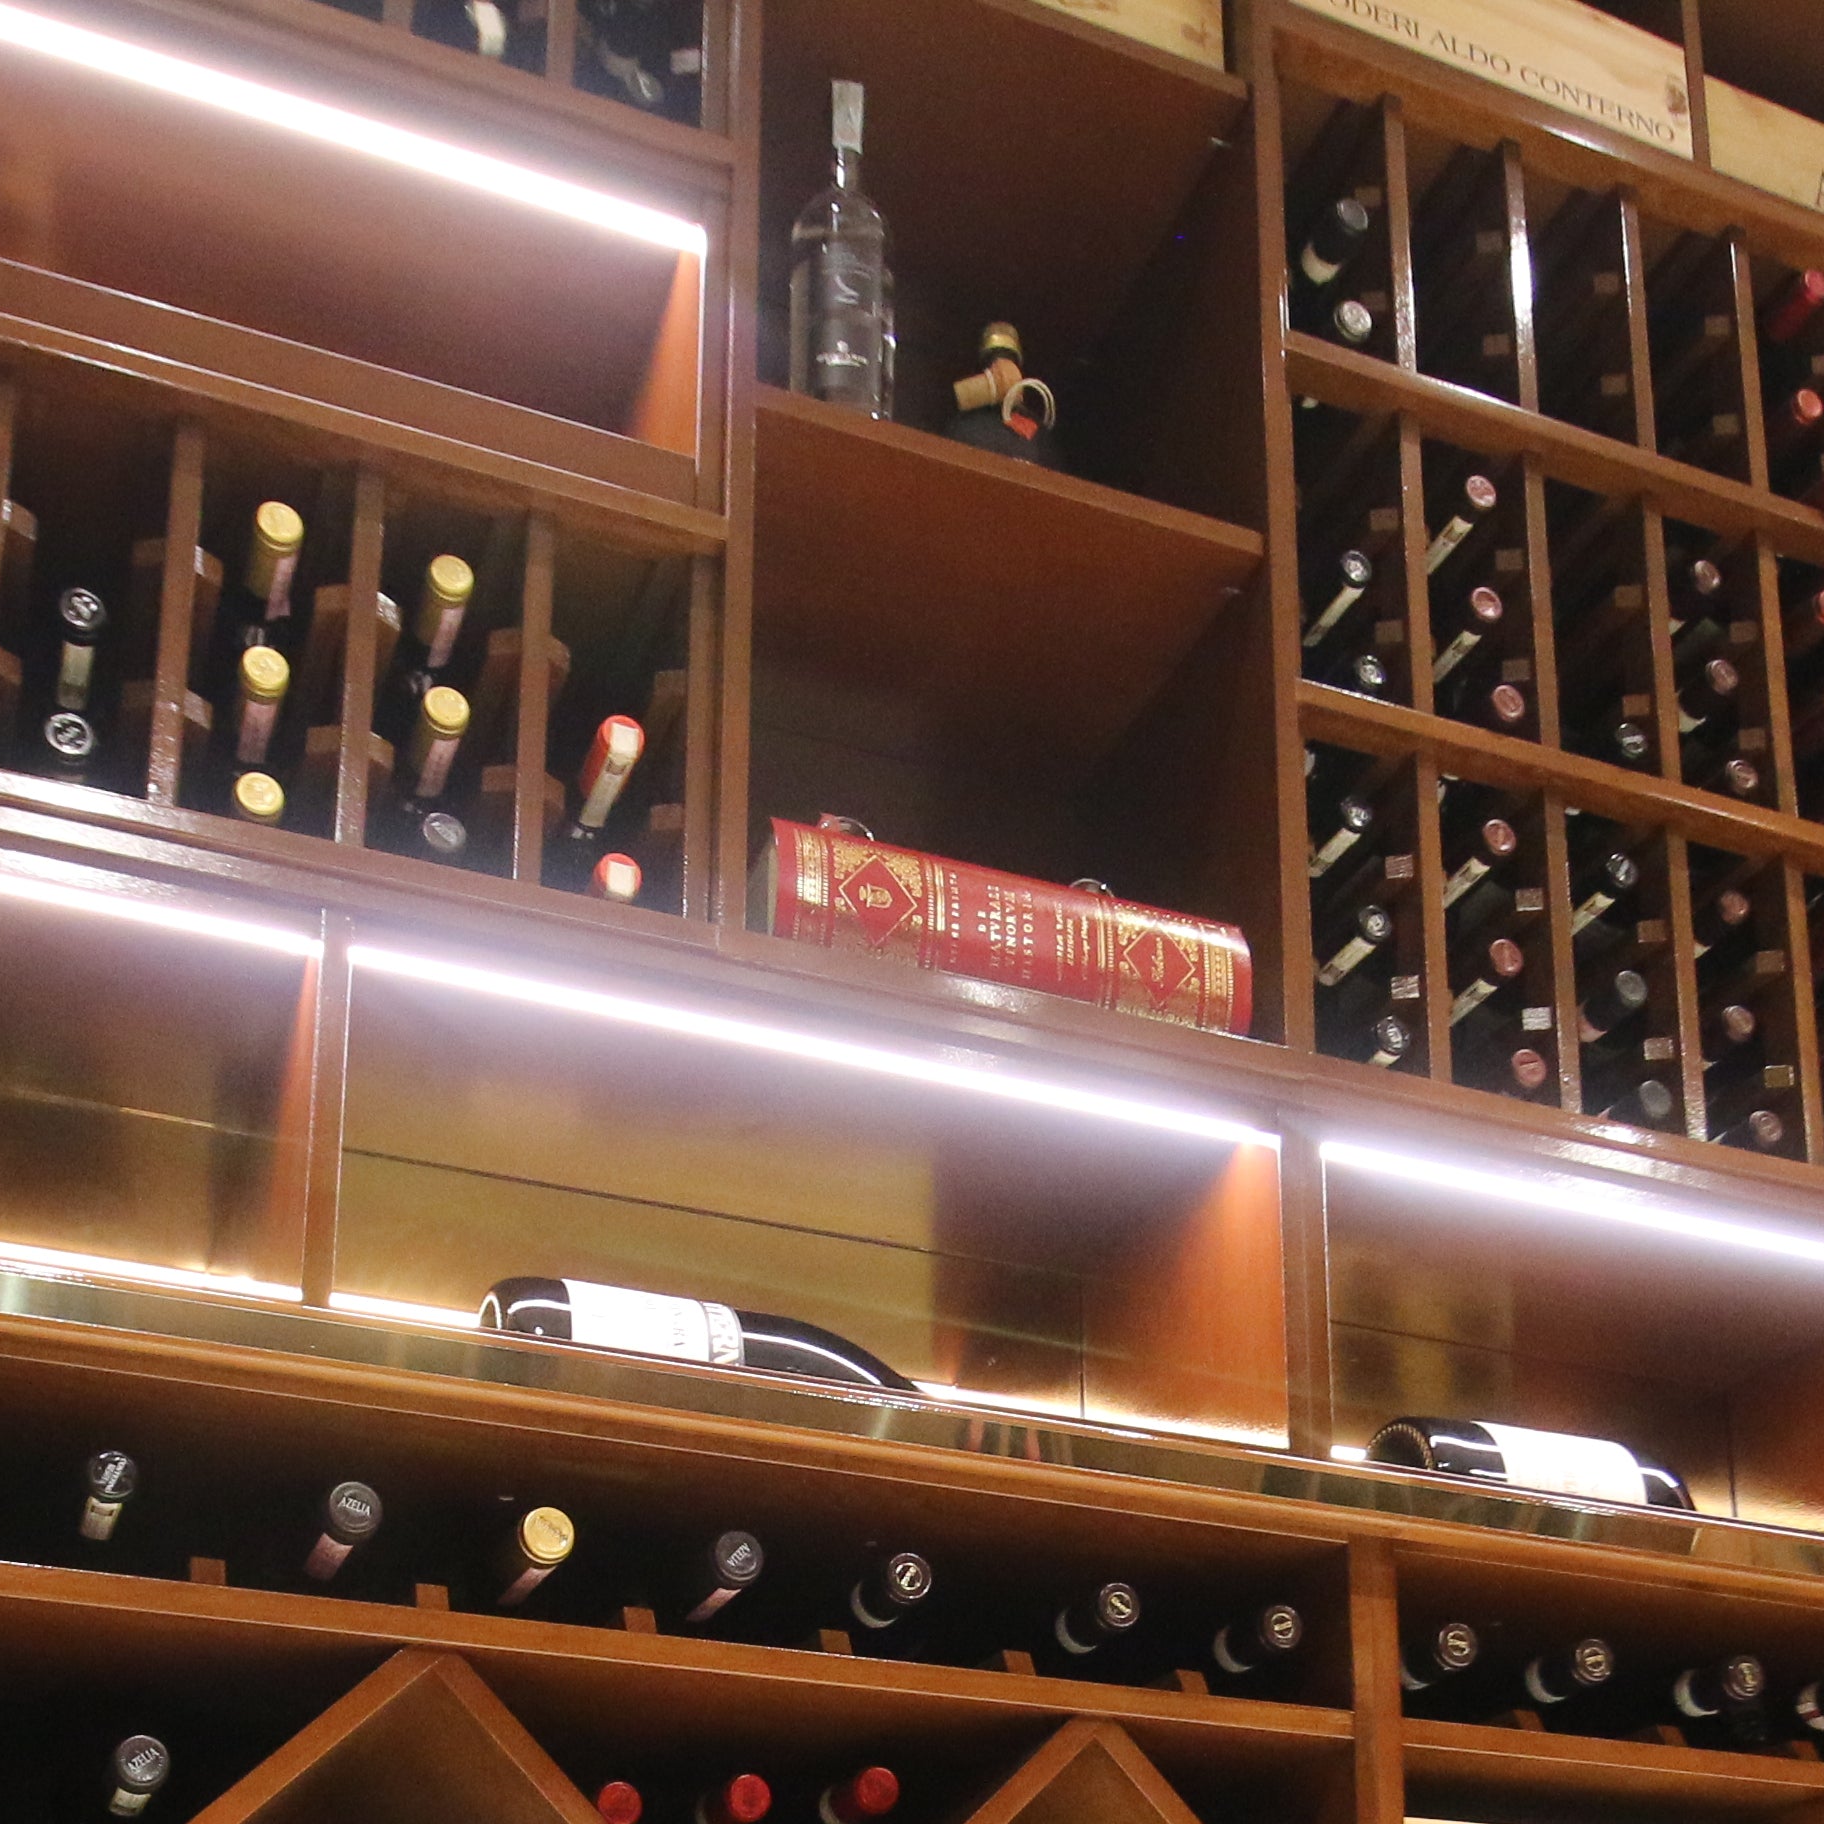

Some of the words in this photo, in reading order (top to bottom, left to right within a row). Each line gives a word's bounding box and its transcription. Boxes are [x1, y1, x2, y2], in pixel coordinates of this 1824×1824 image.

[1430, 29, 1511, 74] ALDO
[1519, 65, 1676, 144] CONTERNO
[338, 1495, 371, 1516] AZELIA
[128, 1747, 159, 1770] AZELIA
